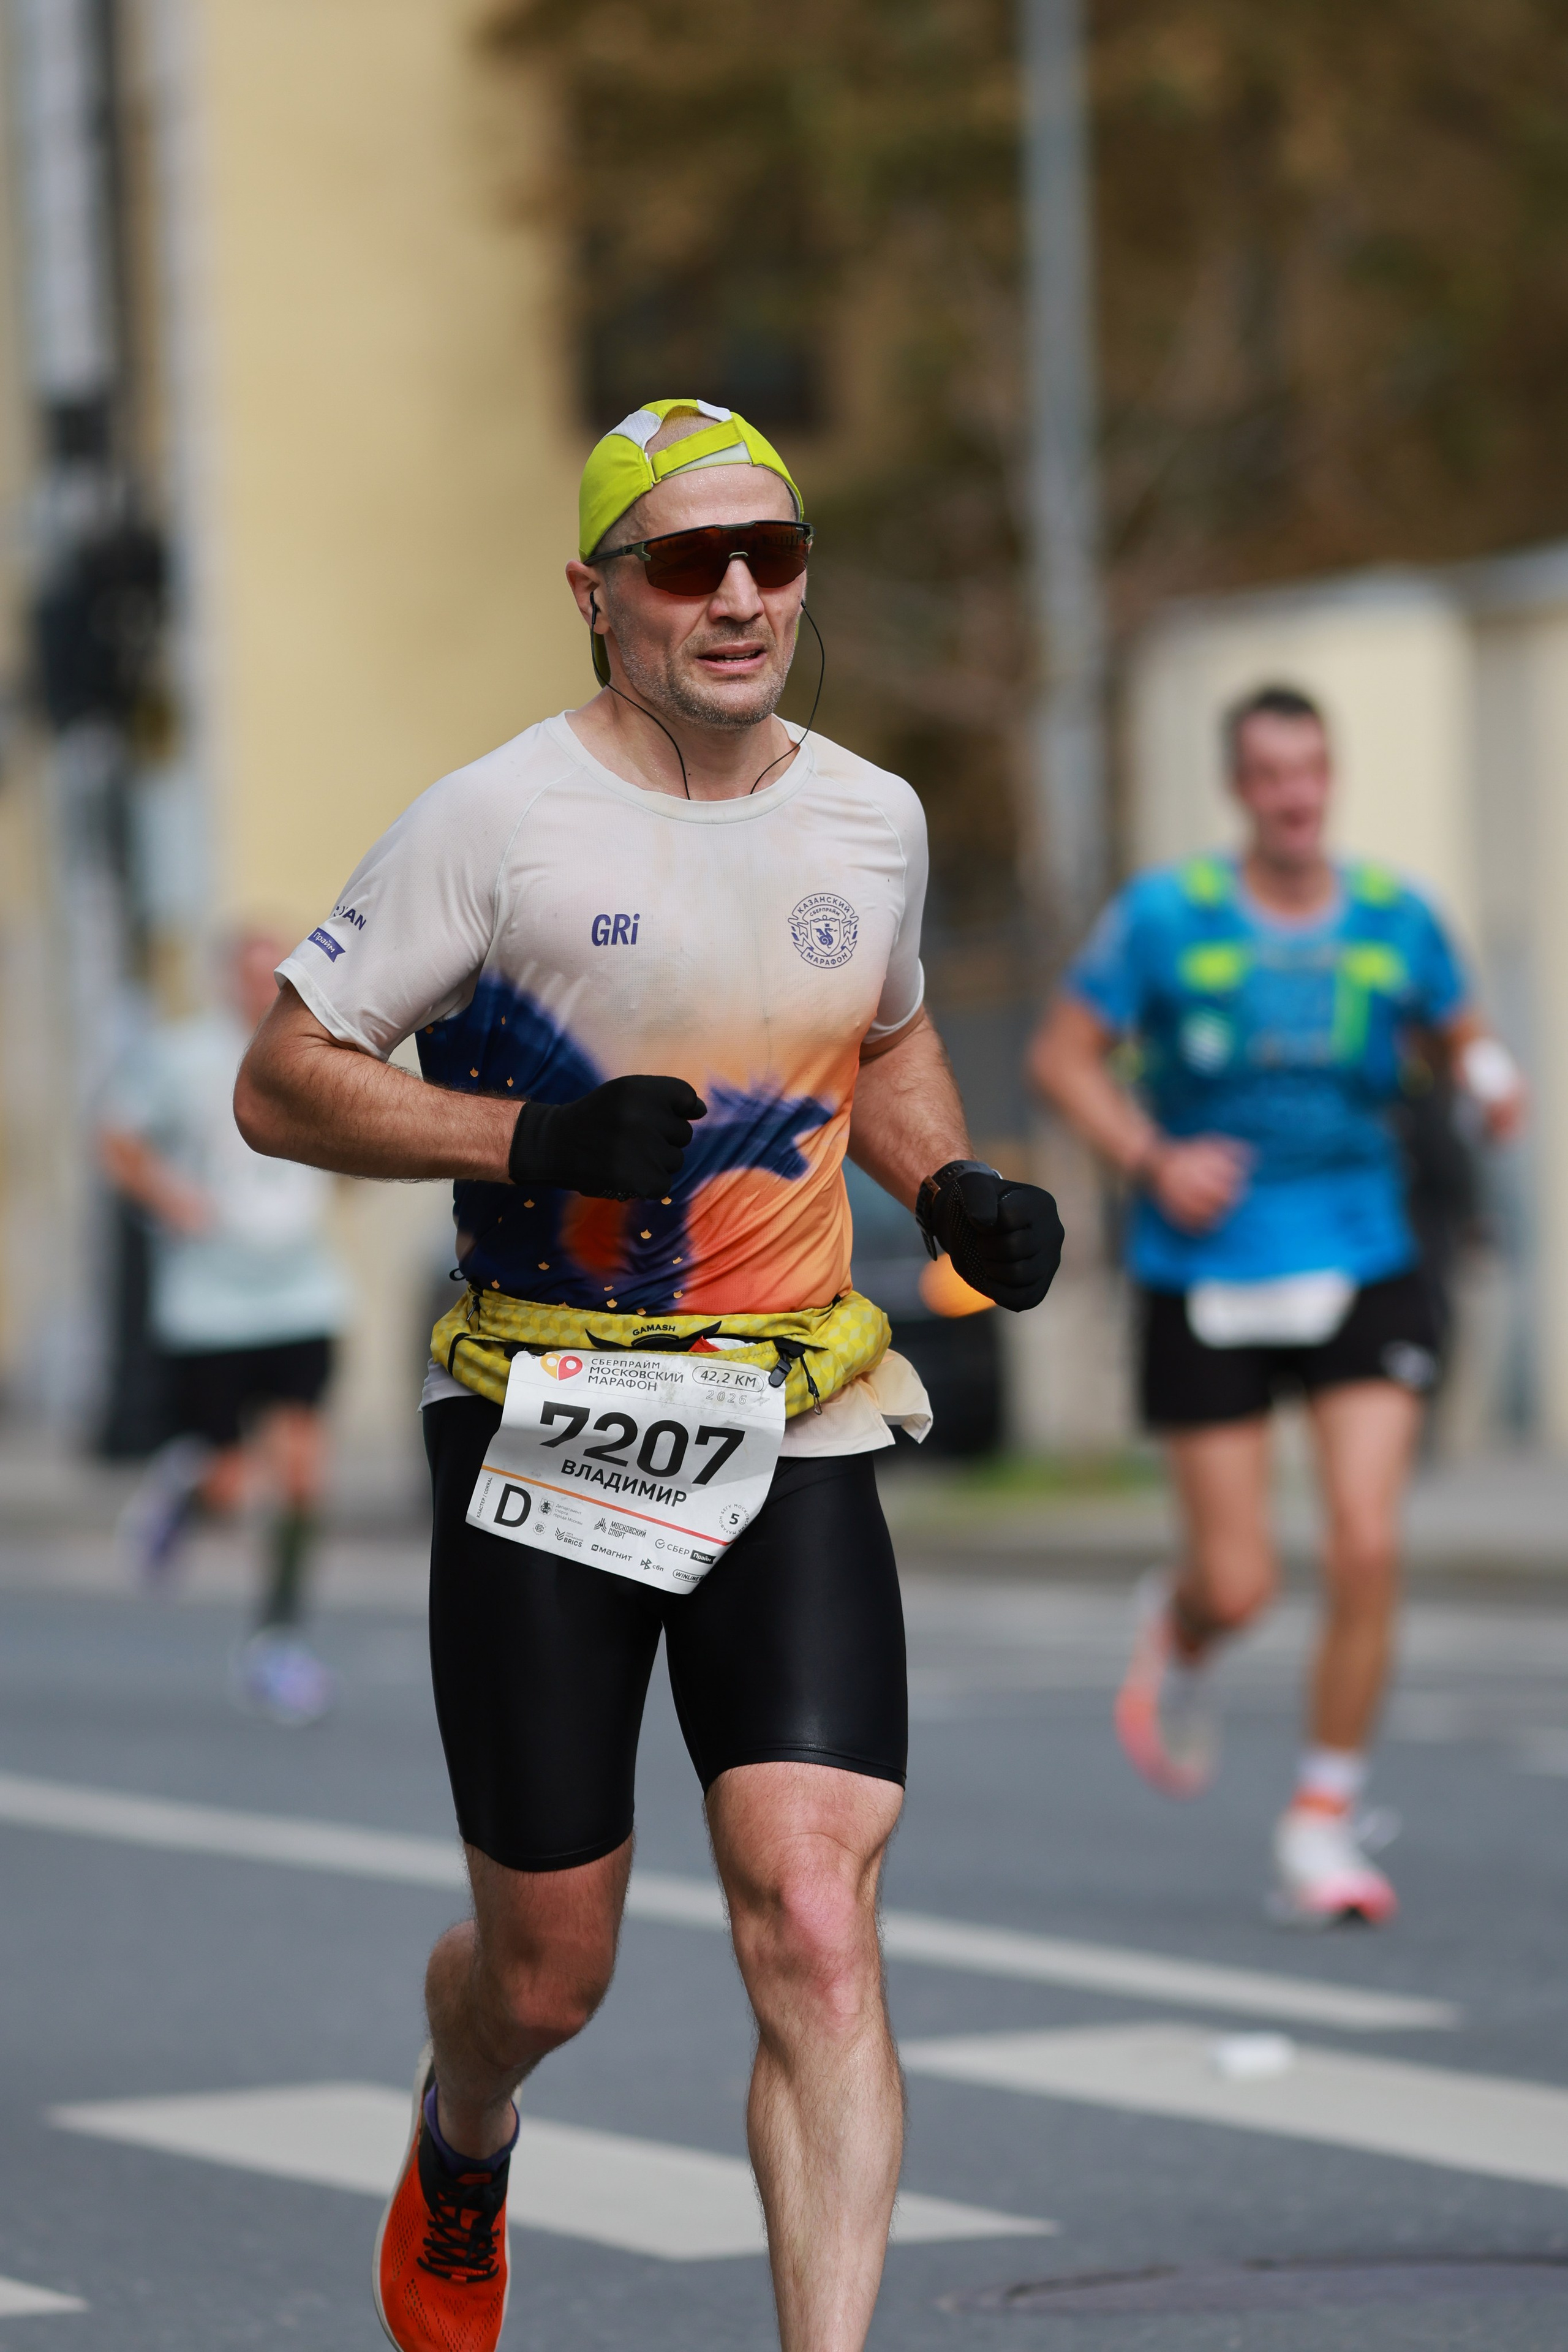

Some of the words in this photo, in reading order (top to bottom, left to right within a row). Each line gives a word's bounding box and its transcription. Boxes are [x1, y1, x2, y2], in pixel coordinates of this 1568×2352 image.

[797, 896, 850, 914] КАЗАНСКИЙ
[809, 907, 840, 916] СБЕРПРАЙМ
[591, 913, 640, 946] GRi
[313, 932, 336, 953] Прайм
[806, 952, 848, 966] МАРАФОН
[633, 1324, 676, 1336] GAMASH
[591, 1359, 660, 1370] СБЕРПРАЙМ
[589, 1366, 684, 1384] МОСКОВСКИЙ
[700, 1370, 730, 1384] 42,2
[587, 1375, 657, 1392] МАРАФОН
[706, 1389, 747, 1405] 2026
[539, 1400, 745, 1486] 7207
[560, 1459, 687, 1507] ВЛАДИМИР
[476, 1497, 486, 1518] КЛАСТЕР
[483, 1477, 493, 1494] CORRAL
[493, 1483, 532, 1528] D
[556, 1504, 582, 1515] Департамент
[729, 1513, 740, 1525] 5
[608, 1528, 626, 1539] СПОРТ
[610, 1521, 647, 1538] МОСКОВСКИЙ
[564, 1537, 582, 1547] BRICS
[666, 1544, 690, 1555] СБЕР
[693, 1552, 712, 1562] Прайм
[675, 1571, 699, 1581] WINLINE
